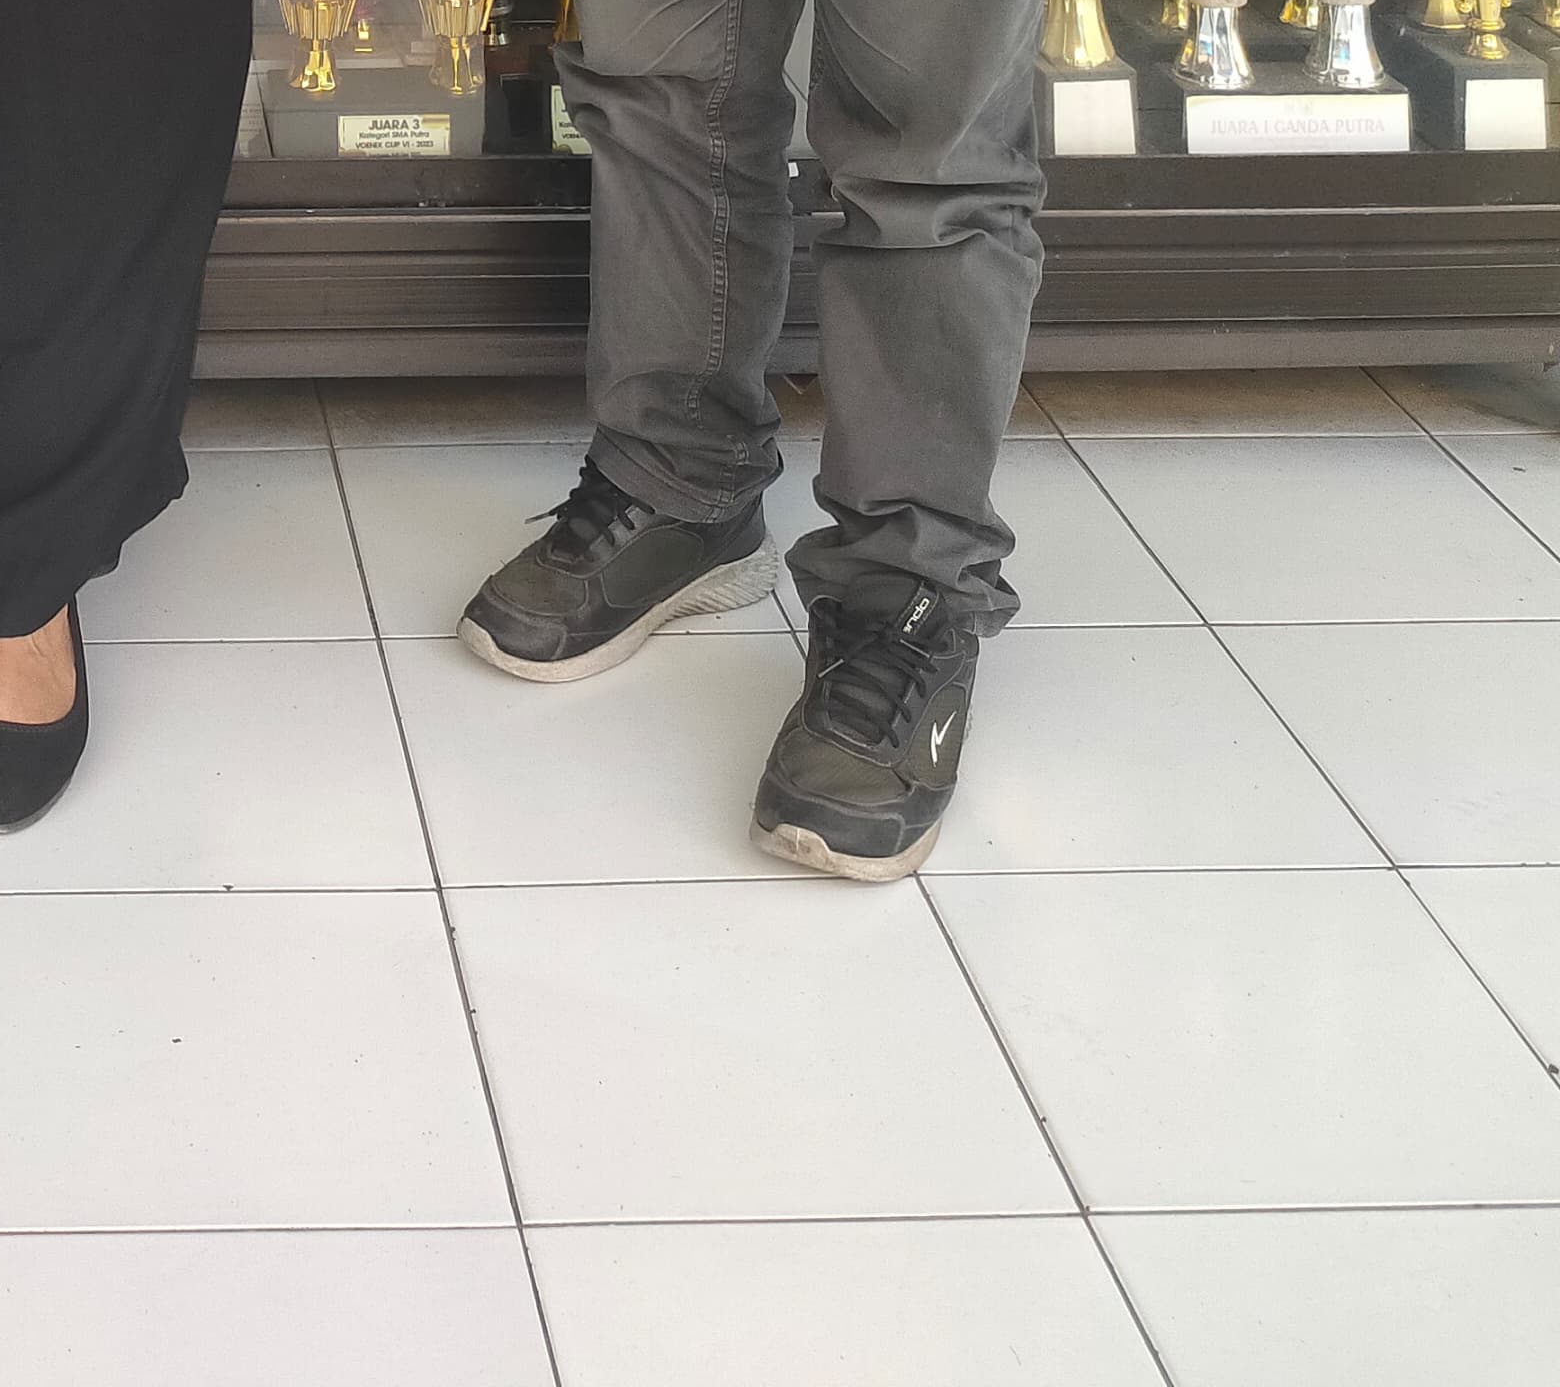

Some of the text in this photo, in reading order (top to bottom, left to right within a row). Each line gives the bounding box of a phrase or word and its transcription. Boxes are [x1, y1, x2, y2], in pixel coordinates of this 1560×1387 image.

[368, 119, 421, 131] JUARA 3
[1210, 119, 1385, 135] JUARA I GANDA PUTRA
[358, 131, 390, 140] Kategori
[392, 131, 409, 139] SMA
[384, 141, 401, 149] CUP
